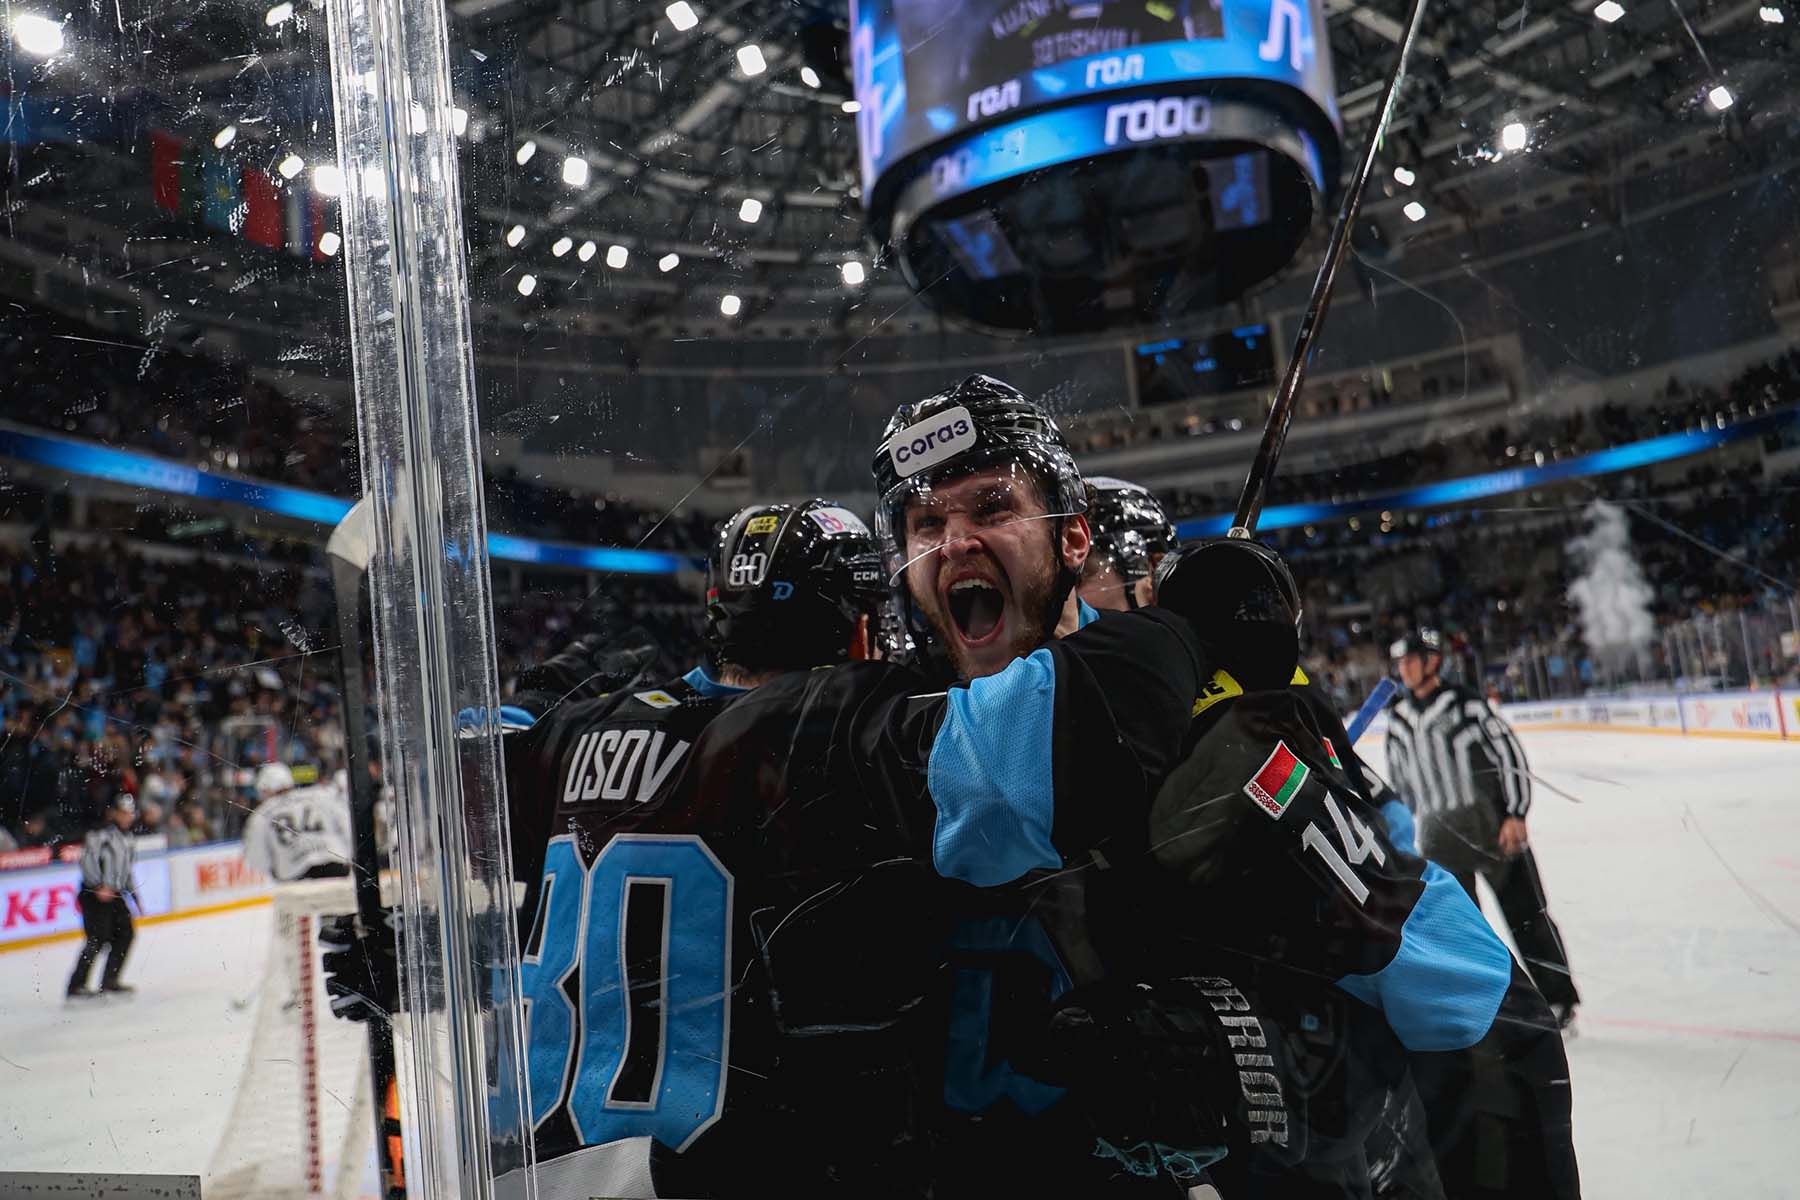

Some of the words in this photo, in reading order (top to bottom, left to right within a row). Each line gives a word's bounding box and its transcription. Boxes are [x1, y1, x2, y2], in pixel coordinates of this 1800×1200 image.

[729, 552, 768, 587] 80
[853, 571, 879, 581] CCM
[563, 728, 692, 803] USOV
[1301, 790, 1387, 907] 14
[3, 884, 84, 930] KF
